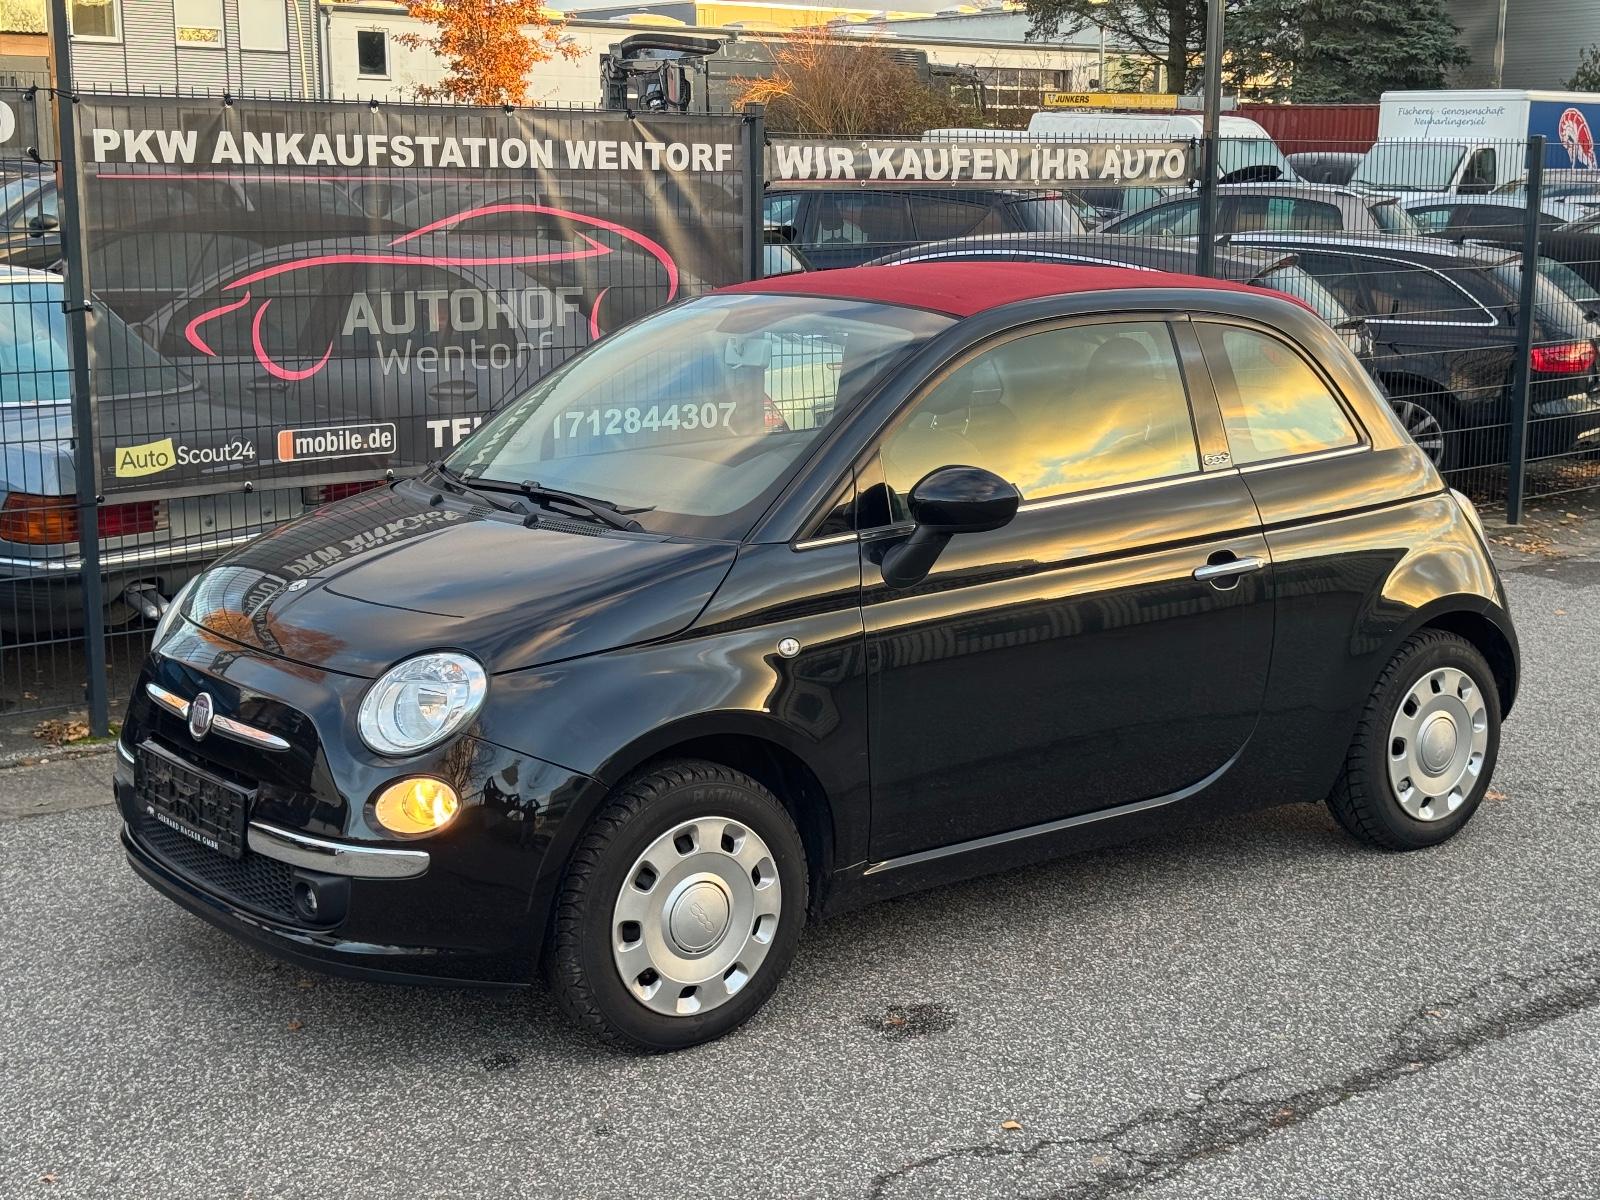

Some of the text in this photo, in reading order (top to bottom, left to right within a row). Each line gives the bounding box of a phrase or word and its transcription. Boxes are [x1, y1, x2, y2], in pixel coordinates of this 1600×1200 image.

[1055, 95, 1090, 104] JUNKERS
[1441, 106, 1505, 117] Genossenschaft
[92, 128, 733, 172] PKW ANKAUFSTATION WENTORF
[775, 144, 1186, 181] WIR KAUFEN IHR AUTO
[341, 286, 584, 336] AUTOHOF
[376, 330, 554, 376] Wentorf
[295, 429, 392, 454] mobile.de
